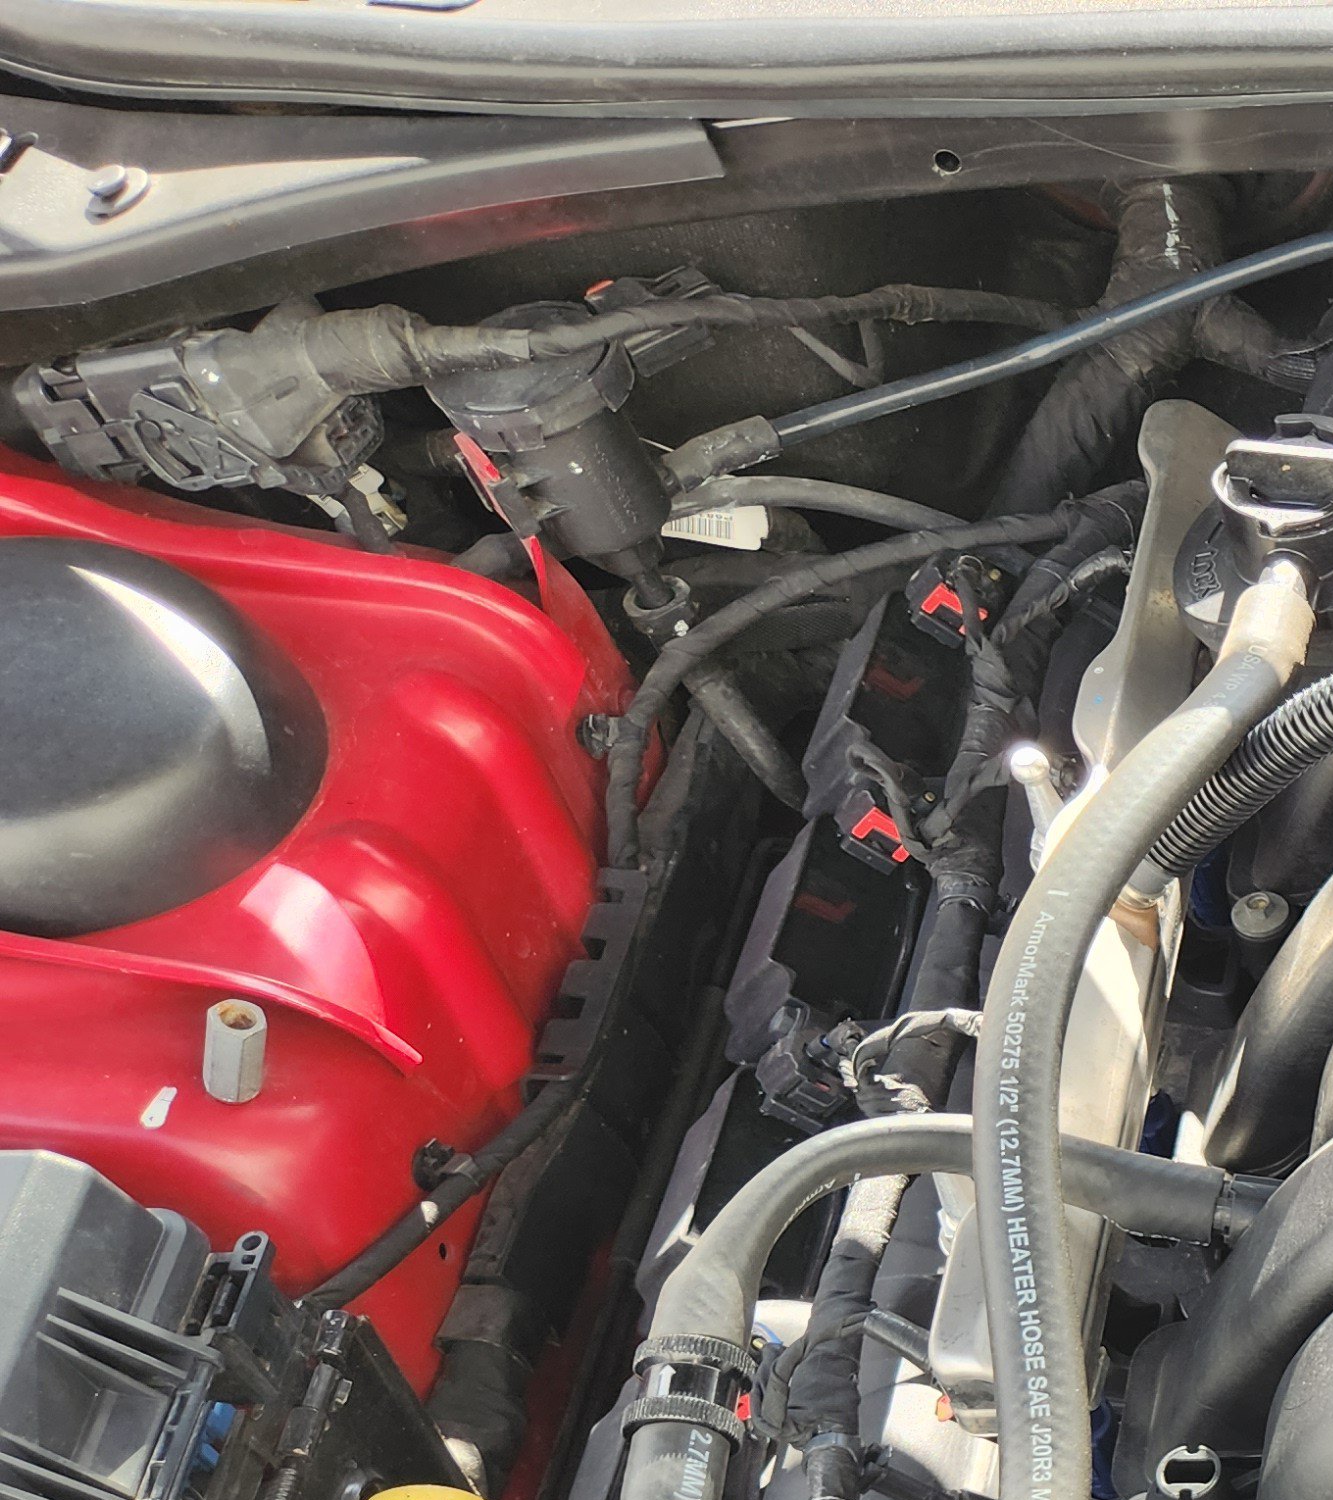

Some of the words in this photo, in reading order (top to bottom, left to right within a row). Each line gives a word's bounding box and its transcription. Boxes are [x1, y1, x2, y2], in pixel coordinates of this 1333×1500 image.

[1246, 644, 1269, 672] USA
[1010, 909, 1055, 1008] ArmorMark
[1001, 1011, 1026, 1070] 50275
[999, 1075, 1020, 1113] 1/2"
[995, 1118, 1026, 1213] (12.7MM)
[1007, 1216, 1037, 1307] HEATER
[1018, 1309, 1046, 1373] HOSE
[1026, 1374, 1051, 1420] SAE
[1027, 1423, 1053, 1482] J20R3
